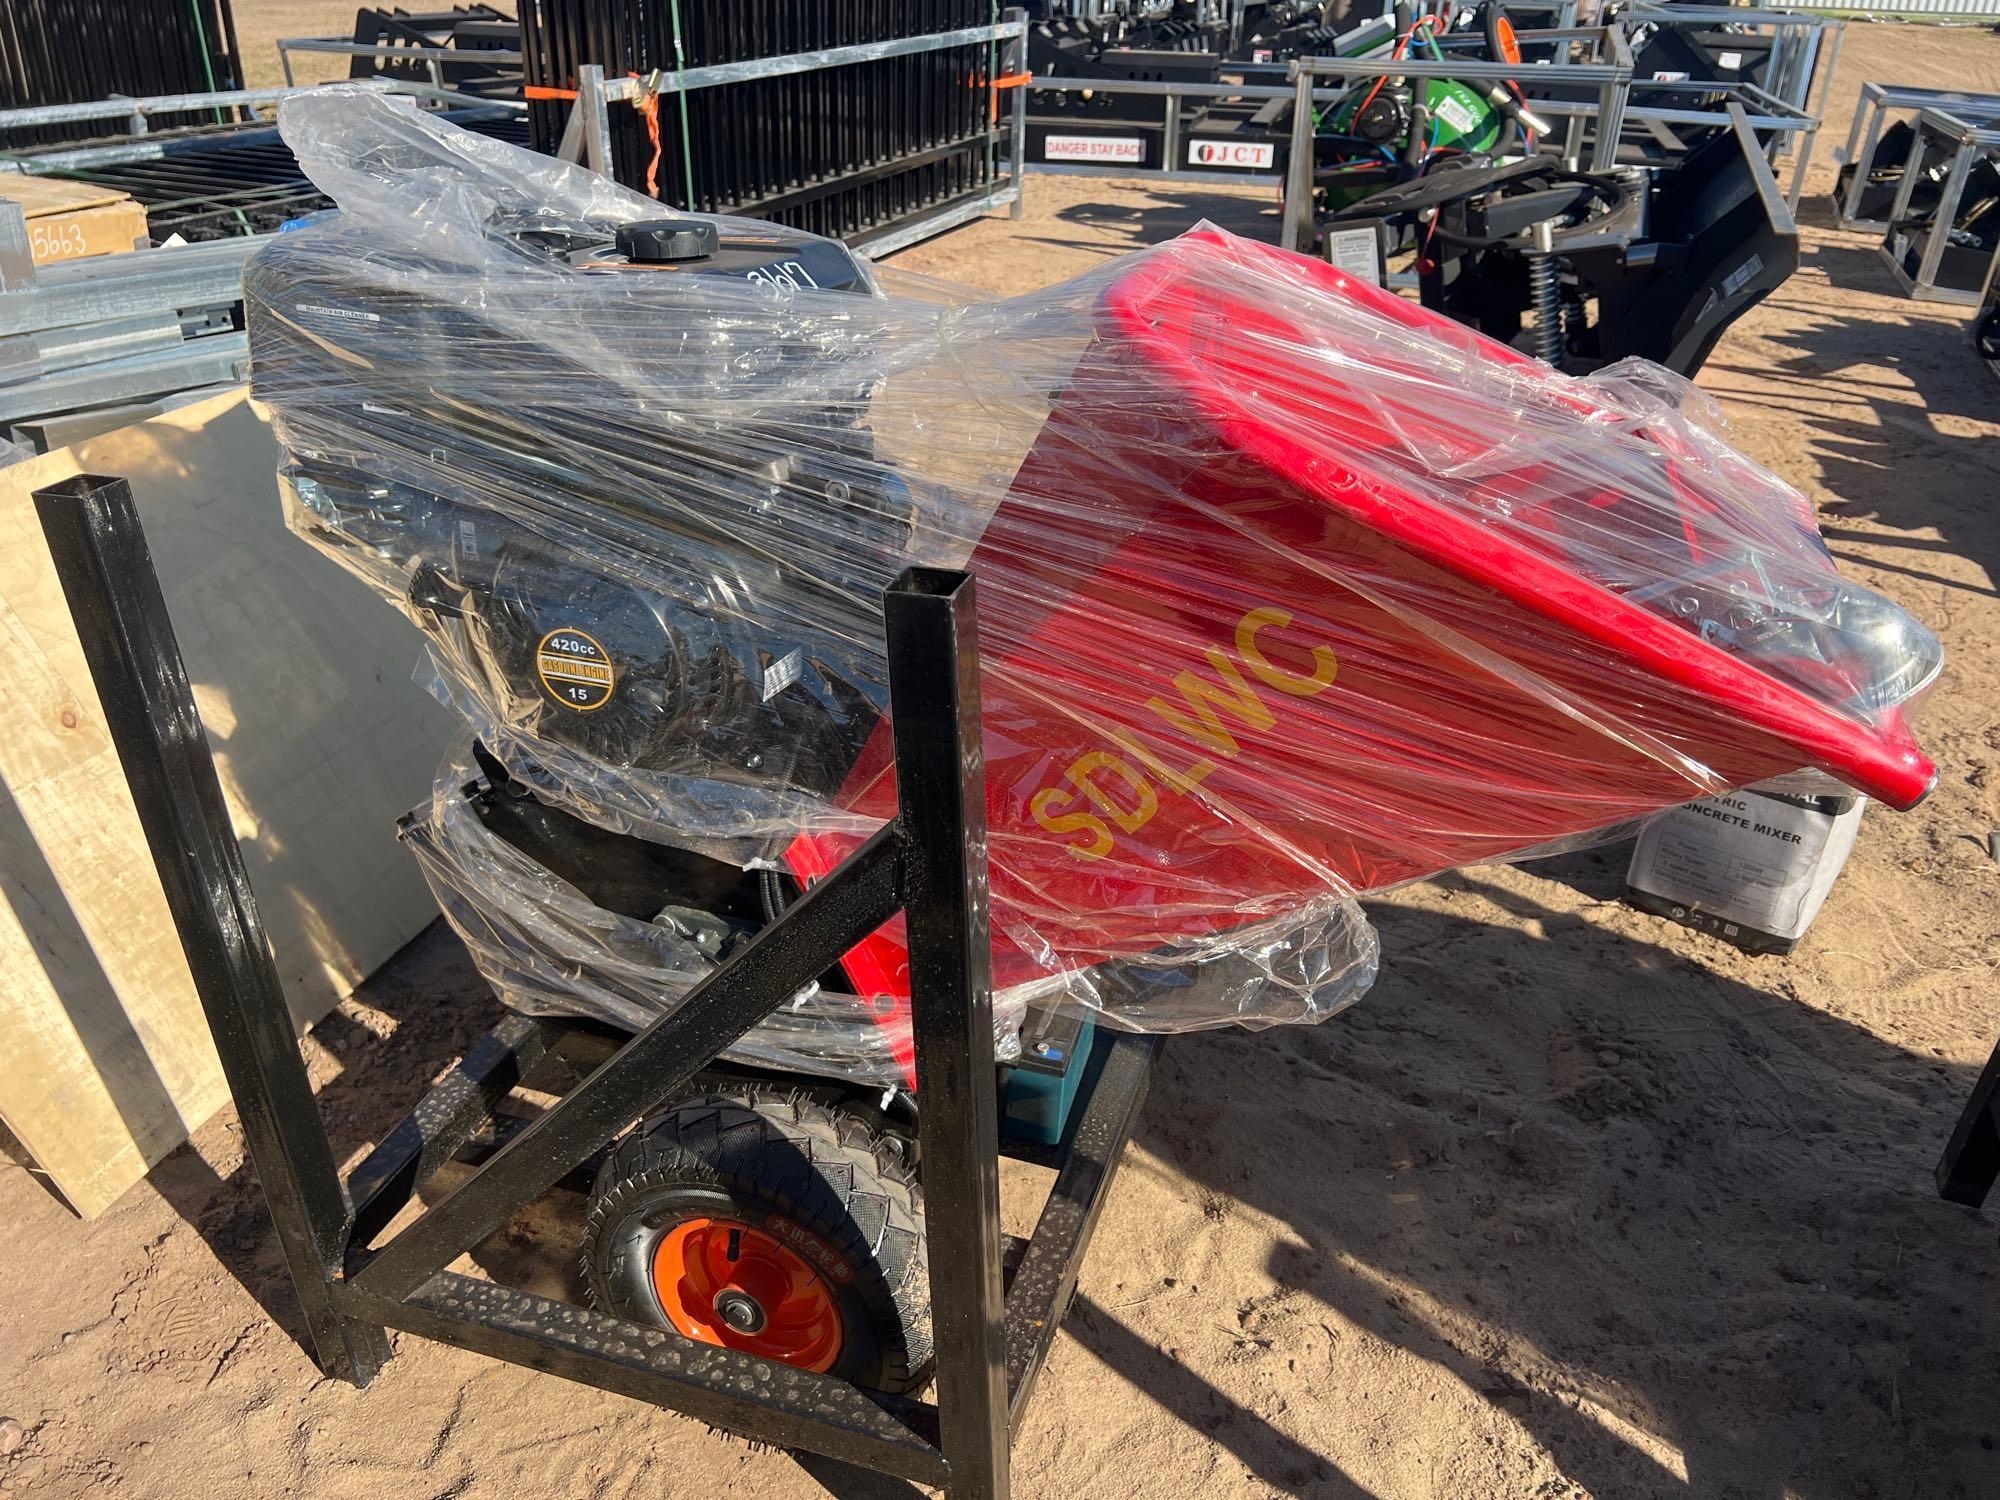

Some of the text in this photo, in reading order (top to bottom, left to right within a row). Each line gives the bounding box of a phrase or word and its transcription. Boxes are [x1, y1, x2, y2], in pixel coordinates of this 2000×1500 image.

[1047, 141, 1144, 157] DANGER STAY BACK
[1217, 145, 1267, 163] JCT
[550, 638, 596, 655] 420cc
[542, 658, 609, 680] GASOLINE ENGINE
[568, 687, 588, 701] 15
[1030, 606, 1338, 862] SDLWC
[1682, 804, 1802, 845] ONCRETE MIXER
